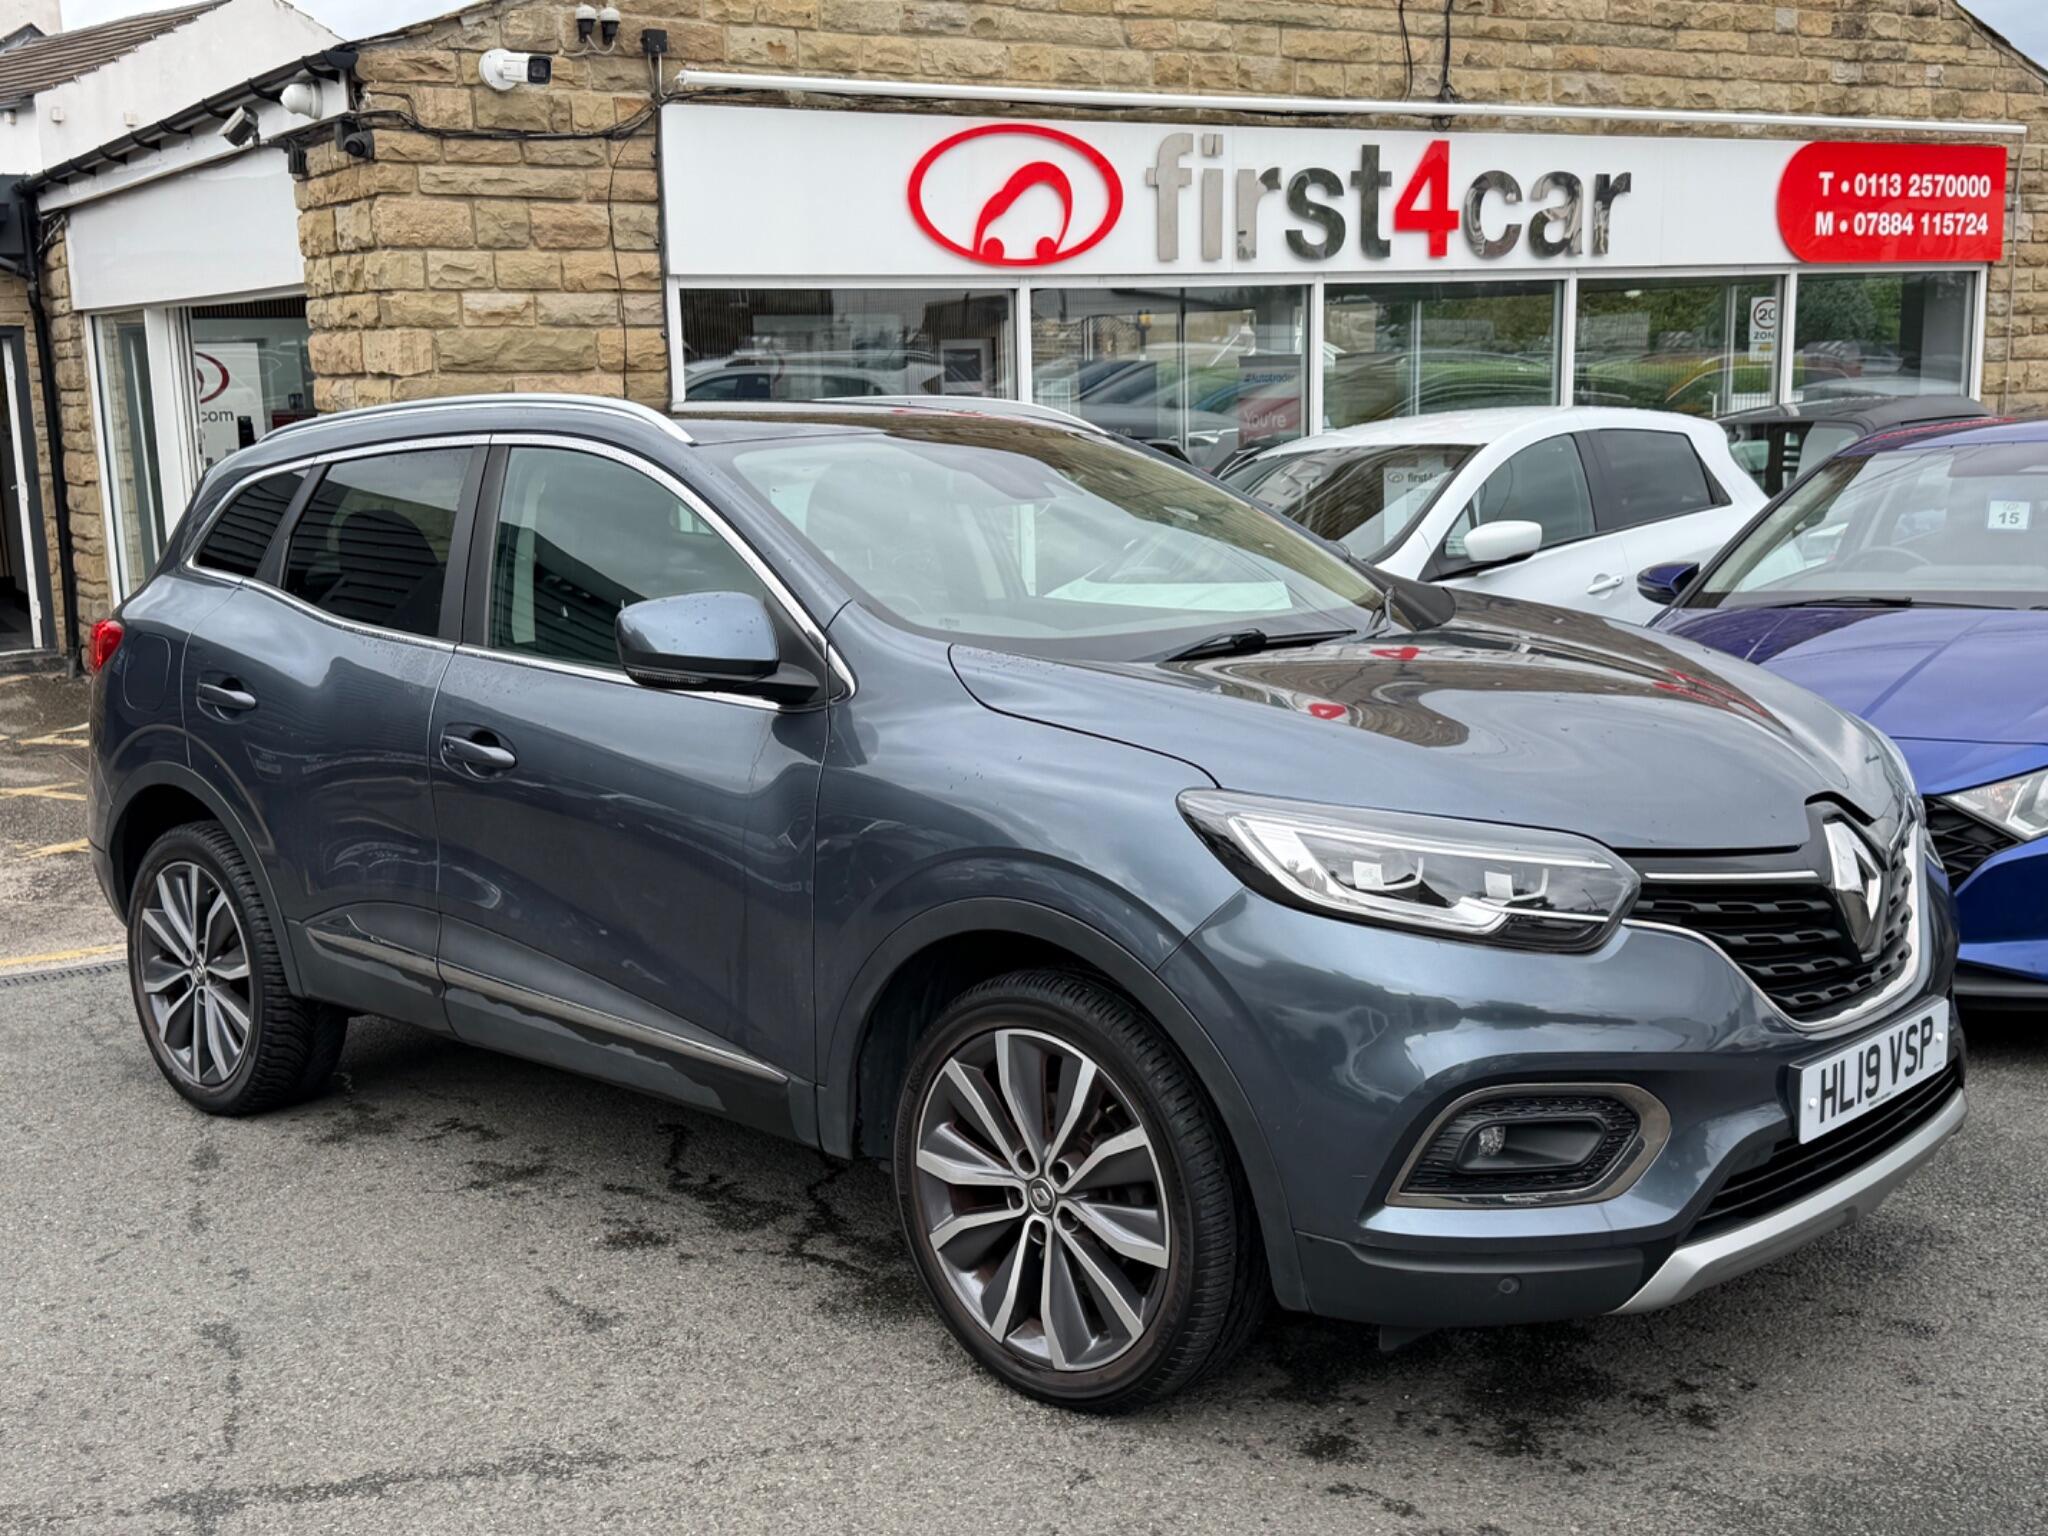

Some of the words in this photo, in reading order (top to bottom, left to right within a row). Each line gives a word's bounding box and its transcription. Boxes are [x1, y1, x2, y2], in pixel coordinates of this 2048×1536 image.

[1145, 132, 1632, 262] first4car
[1817, 171, 1835, 197] T
[1853, 172, 1902, 198] 0113
[1907, 173, 1992, 199] 2570000
[1814, 210, 1835, 237] M
[1853, 211, 1915, 237] 07884
[1919, 211, 1989, 237] 115724
[1754, 331, 1774, 340] ZON
[1243, 410, 1287, 429] You're
[1998, 511, 2020, 524] 15
[1819, 1043, 1882, 1124] HL19
[1889, 1015, 1934, 1086] VSP
